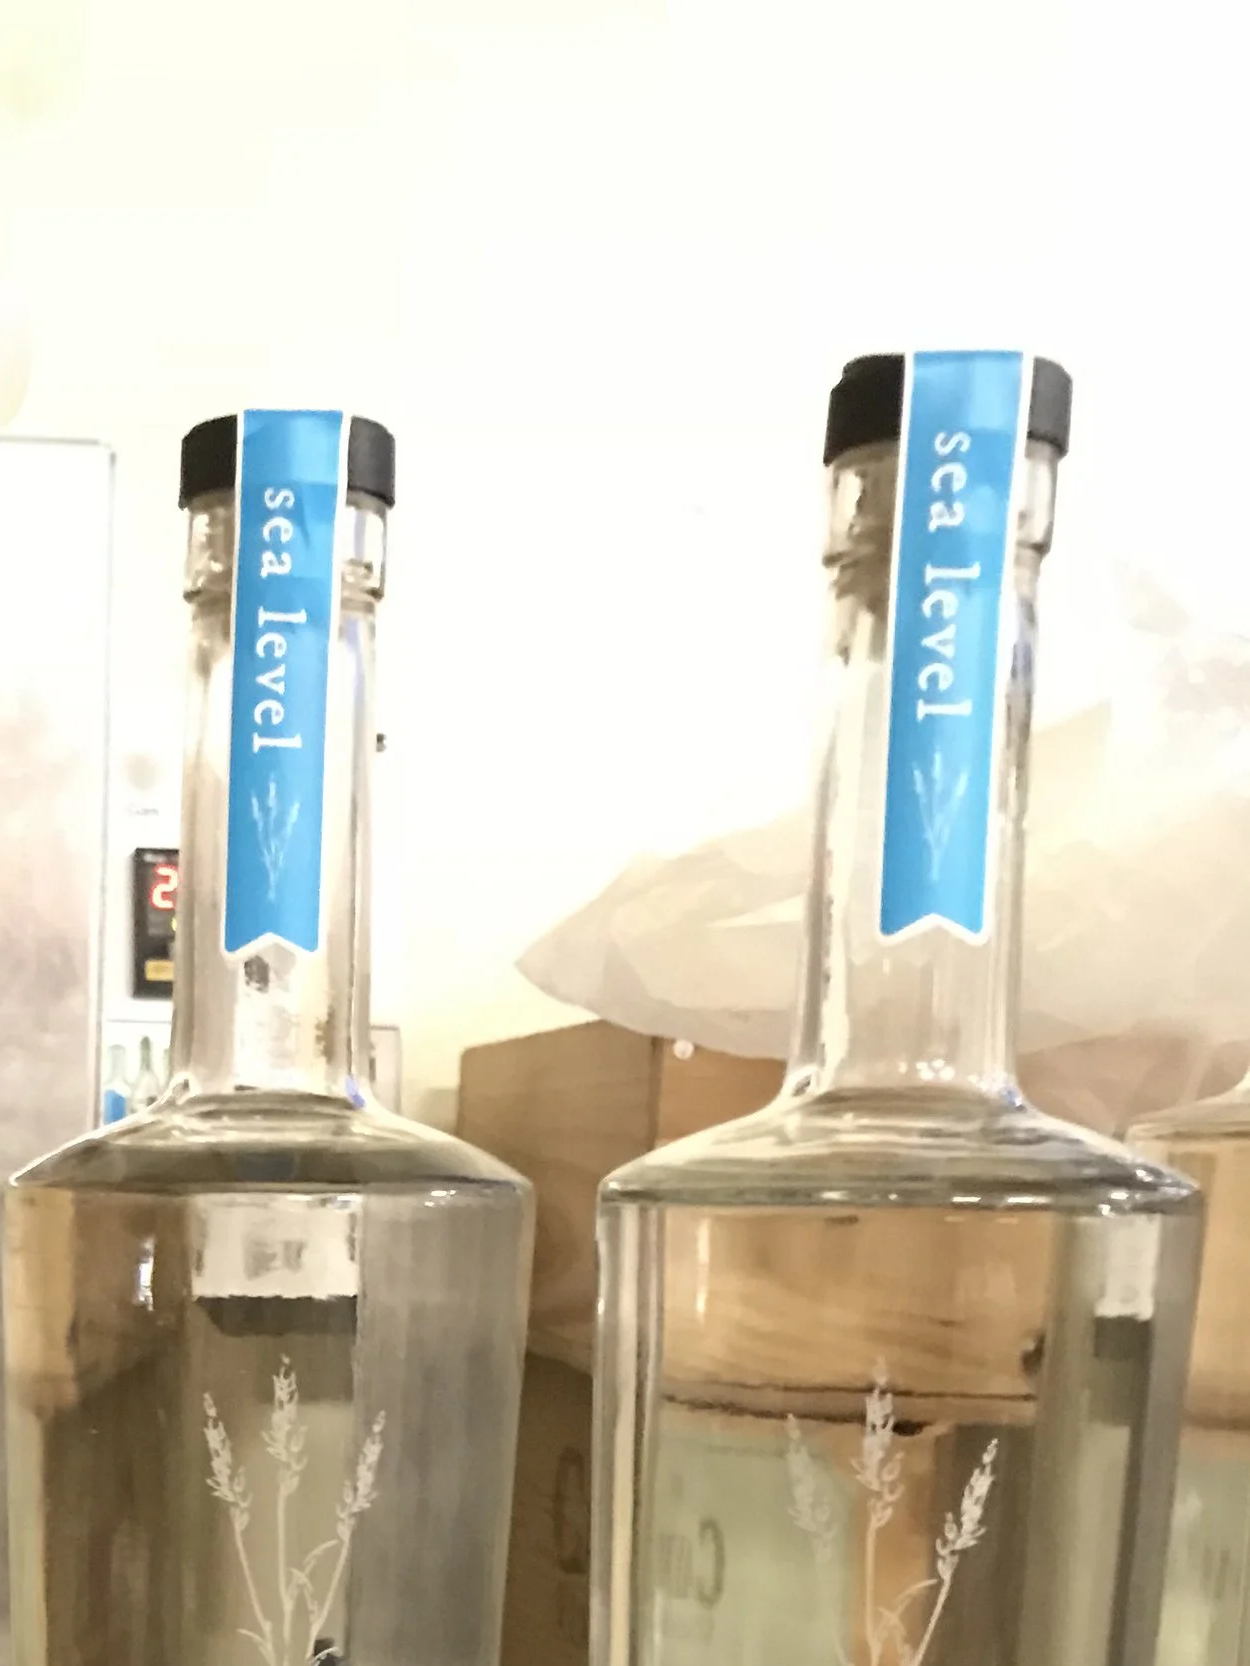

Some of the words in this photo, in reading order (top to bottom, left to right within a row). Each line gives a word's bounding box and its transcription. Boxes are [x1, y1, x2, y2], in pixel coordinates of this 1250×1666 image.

[260, 485, 296, 580] sea
[926, 429, 972, 535] sea
[251, 605, 310, 755] level
[915, 559, 982, 724] level
